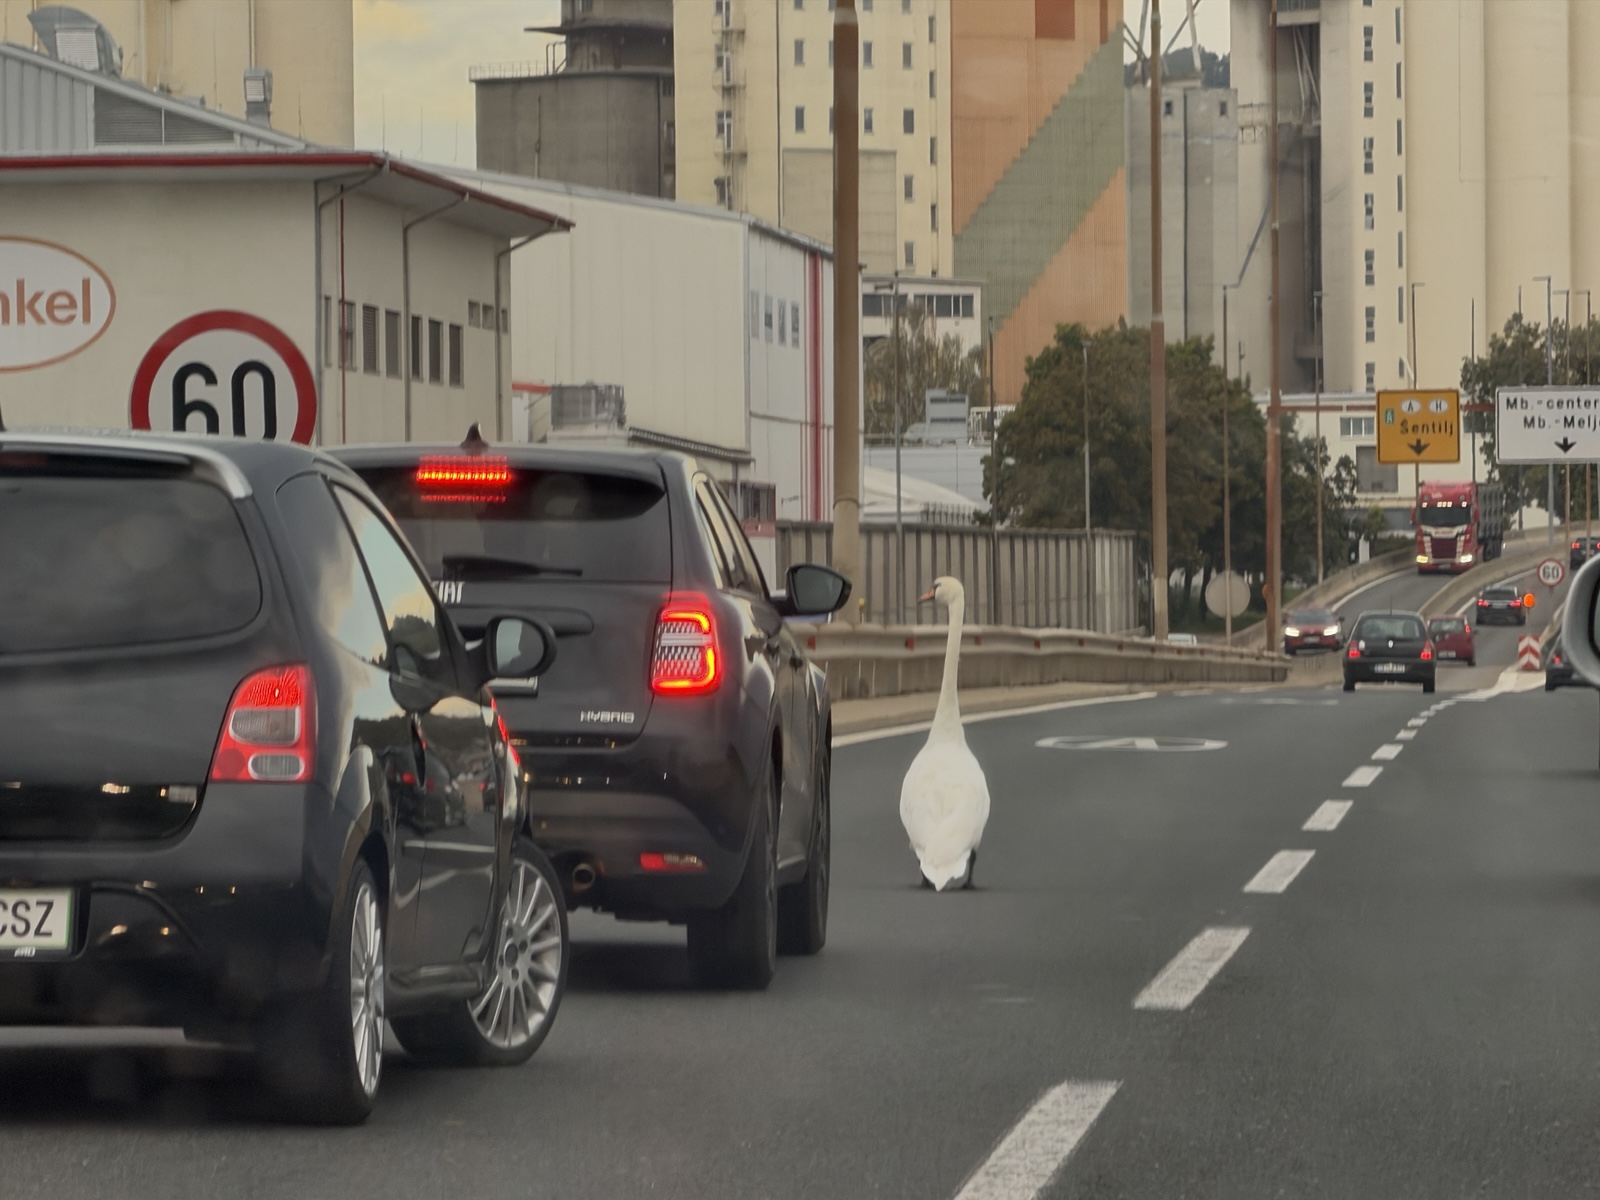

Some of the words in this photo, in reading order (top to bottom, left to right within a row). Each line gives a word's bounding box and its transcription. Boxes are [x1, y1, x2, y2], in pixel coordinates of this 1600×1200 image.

[172, 360, 277, 440] 60
[1523, 414, 1600, 433] Mb.-Melj
[1542, 565, 1559, 581] 60
[580, 710, 635, 724] HYBRID
